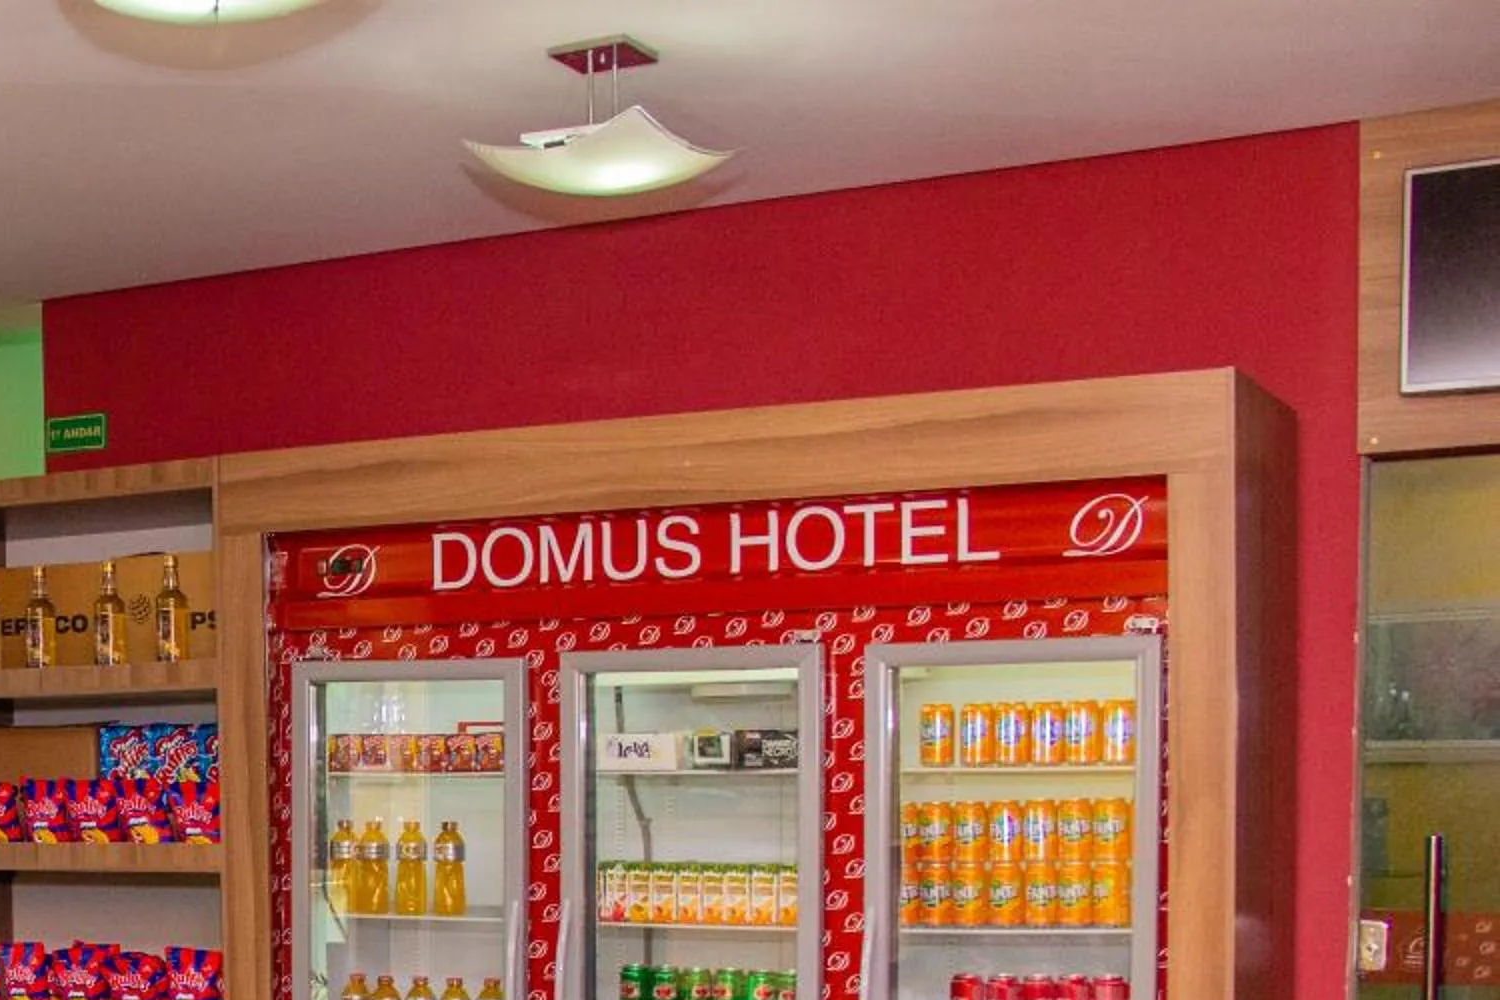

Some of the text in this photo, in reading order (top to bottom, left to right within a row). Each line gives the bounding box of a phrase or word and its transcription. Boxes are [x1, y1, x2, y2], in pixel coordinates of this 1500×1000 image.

[63, 425, 101, 440] ANDAR
[431, 497, 1001, 591] DOMUS HOTEL
